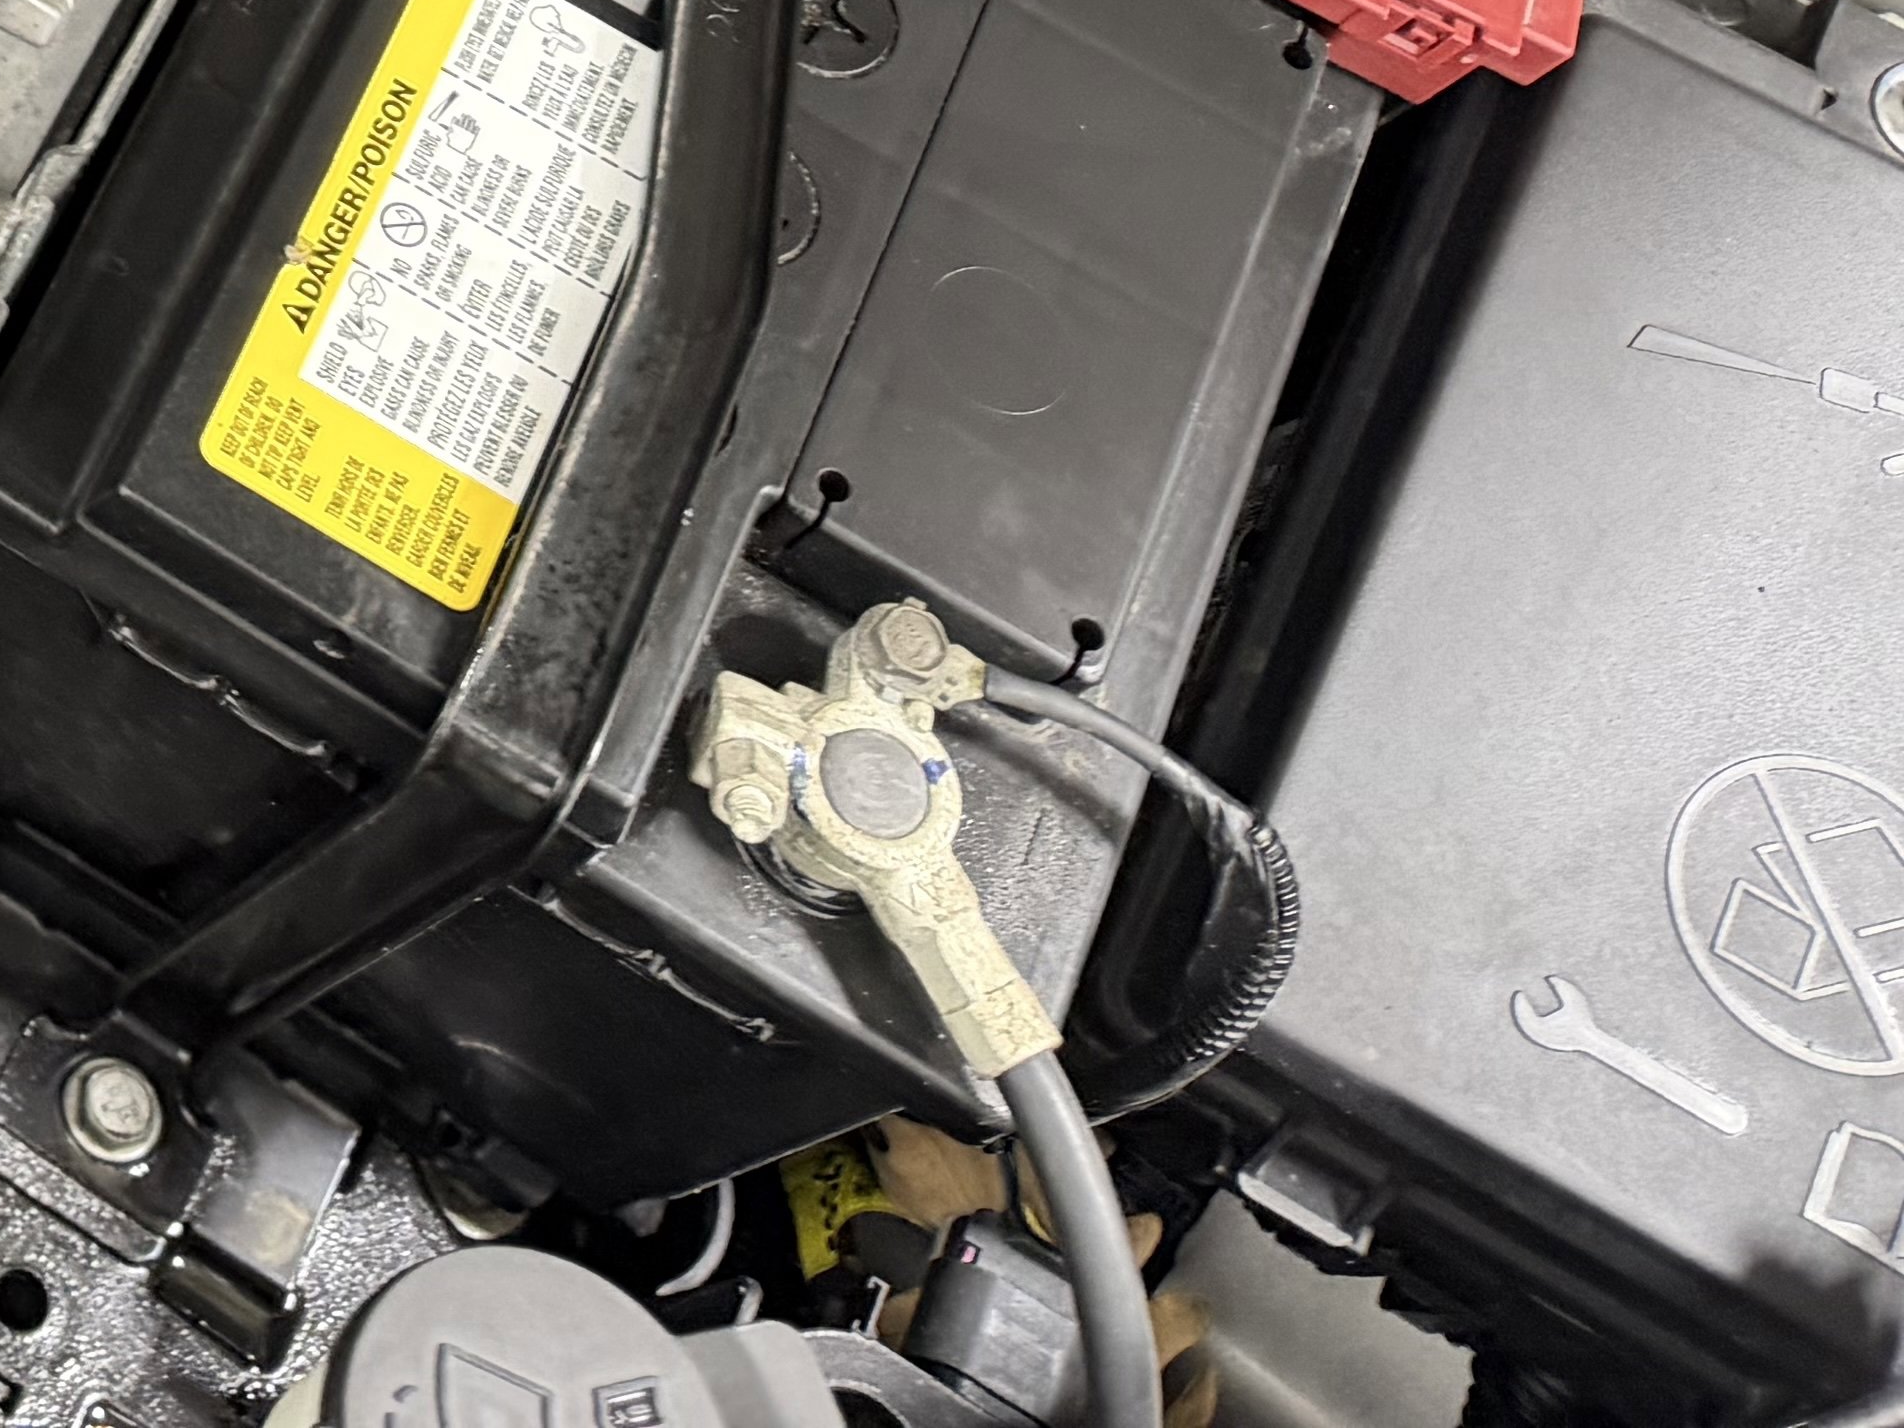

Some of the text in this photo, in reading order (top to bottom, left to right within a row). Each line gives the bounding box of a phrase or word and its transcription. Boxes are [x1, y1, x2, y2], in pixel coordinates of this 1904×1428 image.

[535, 59, 556, 80] LES
[404, 128, 442, 181] SULFURIC
[491, 153, 511, 171] OR
[425, 163, 453, 193] ACID
[532, 142, 577, 208] SULFURIQUE
[295, 77, 418, 303] DANGER/POISON
[448, 181, 471, 205] CAN
[565, 183, 585, 201] LA
[429, 212, 460, 253] FLAMES
[574, 221, 594, 240] OU
[388, 256, 413, 279] NO
[433, 242, 473, 303] OR SMOKING
[456, 275, 494, 320] ÉVITER
[482, 308, 507, 332] LES
[505, 321, 527, 344] LES
[525, 337, 548, 357] DE
[314, 340, 349, 384] SHIELD
[336, 363, 365, 397] EYES
[357, 354, 395, 408] EXPLOSIVE
[379, 335, 431, 421] GASES CAN CAUSE
[400, 329, 460, 433] BLINDNESS OR INJURY
[422, 338, 490, 450] PROTÉGEZ LES YEUX
[236, 402, 256, 420] OF
[282, 396, 306, 424] VENT
[449, 370, 504, 463] LES GAZ EXPLOSIFS
[470, 372, 529, 475] PEUVENT BLESSER OU
[228, 414, 251, 437] OUT
[237, 451, 257, 468] OF
[262, 394, 284, 413] DO
[271, 419, 296, 447] KEEP
[298, 416, 321, 441] AND
[386, 470, 410, 493] PAS
[342, 515, 364, 533] LA
[363, 465, 386, 488] DES
[450, 507, 472, 525] ET
[445, 574, 467, 594] DE
